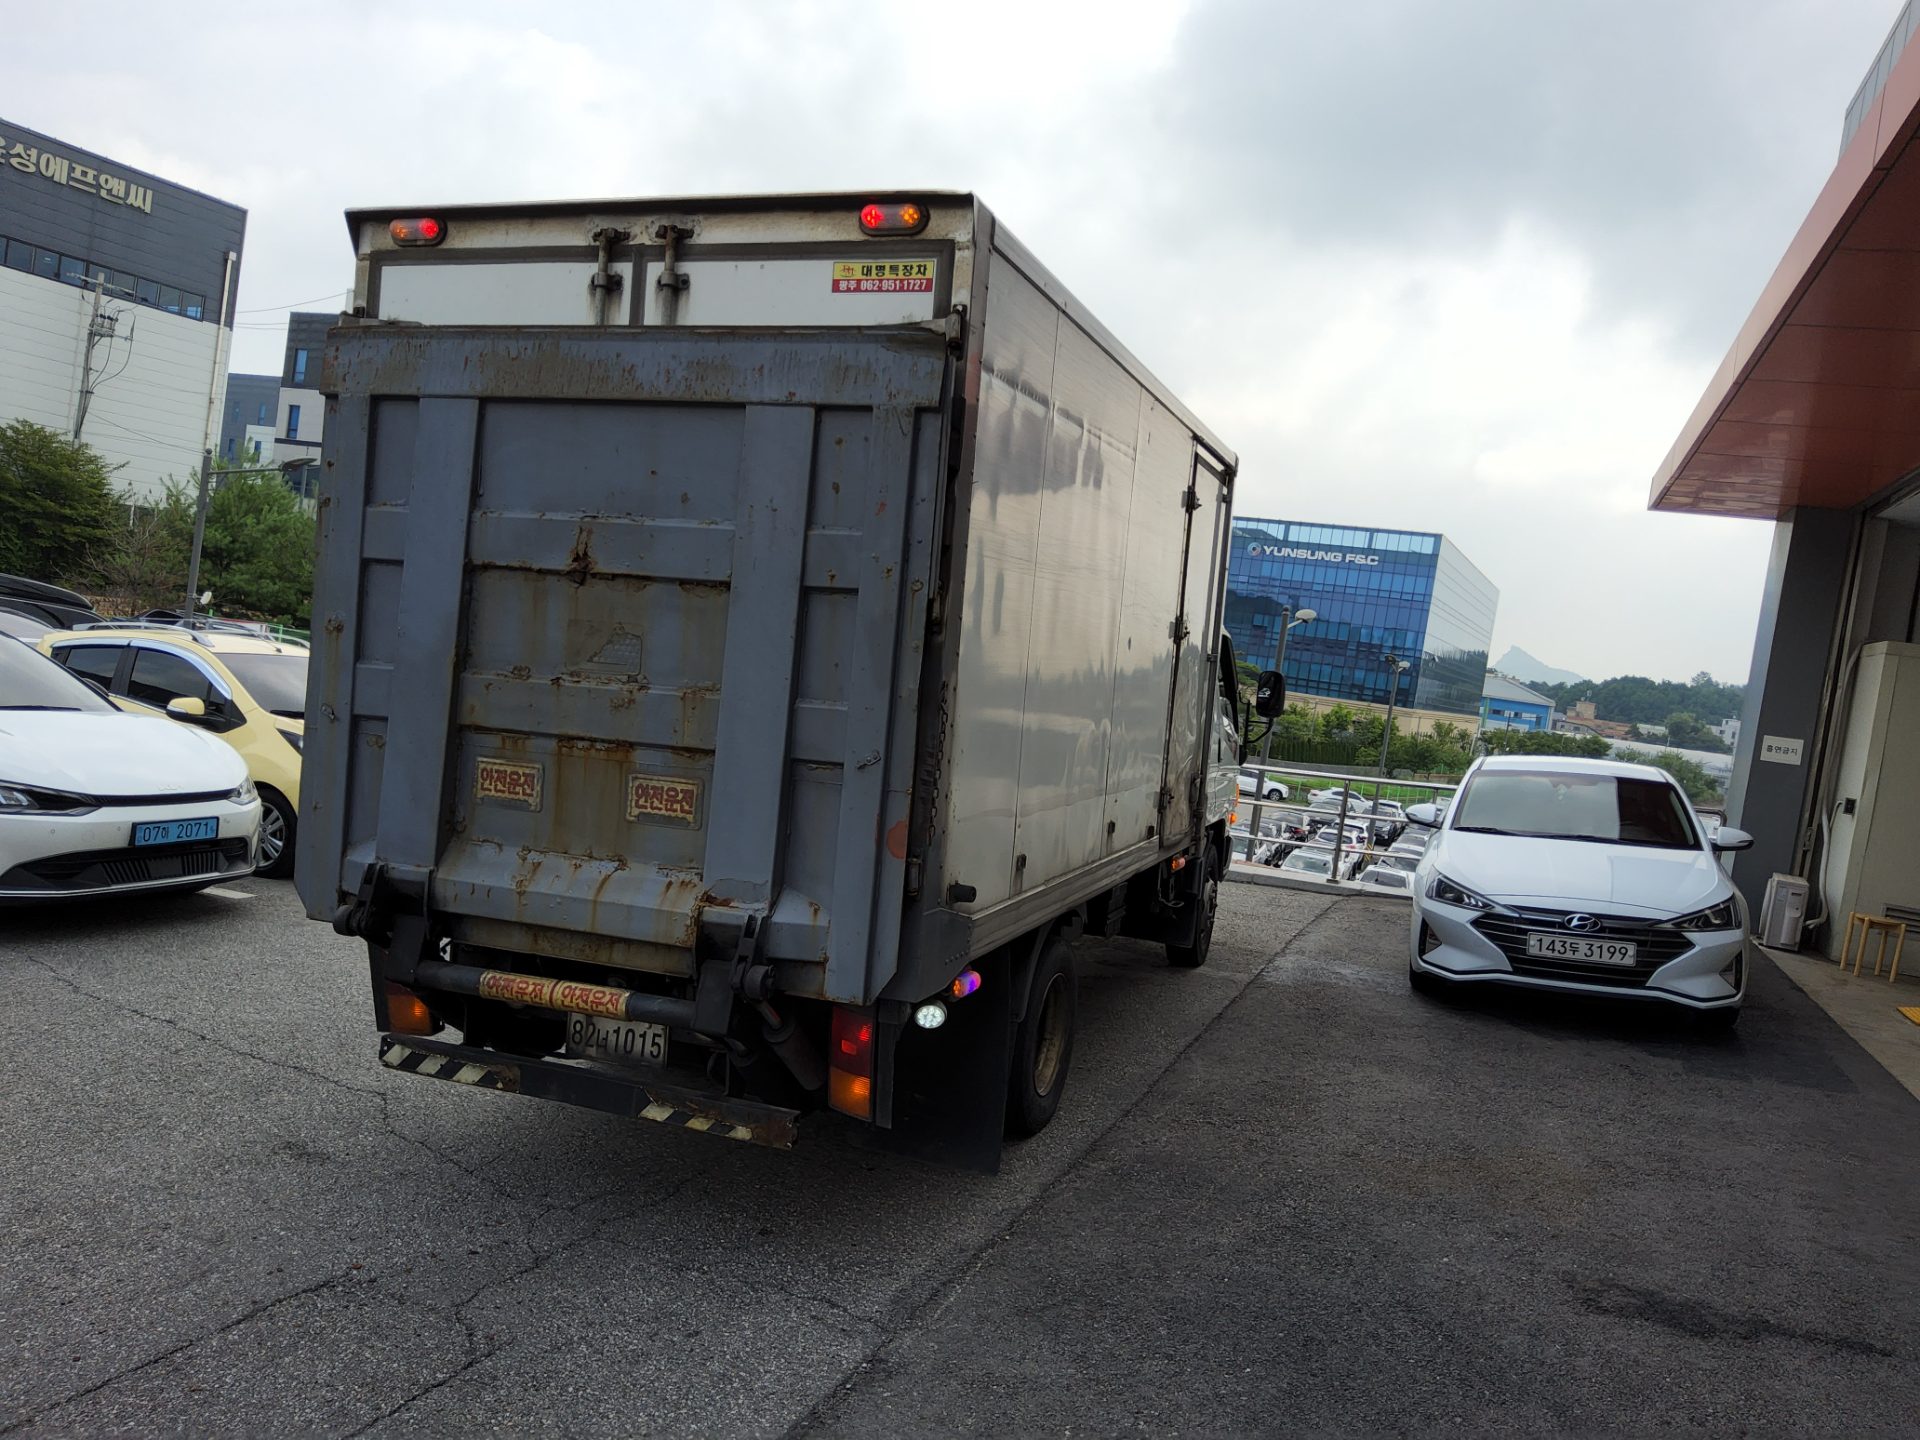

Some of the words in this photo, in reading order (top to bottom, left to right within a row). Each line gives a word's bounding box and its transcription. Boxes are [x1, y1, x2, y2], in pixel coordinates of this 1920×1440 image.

[861, 264, 928, 277] 대명특장차
[838, 280, 857, 291] 광주
[1263, 545, 1342, 562] YUNSUNG
[1345, 553, 1379, 565] F&C
[480, 767, 536, 797] 안전운전
[634, 782, 694, 814] 안전운전
[1584, 943, 1629, 961] 3199
[486, 975, 545, 1006] 안전운전
[560, 984, 622, 1016] 안전운전
